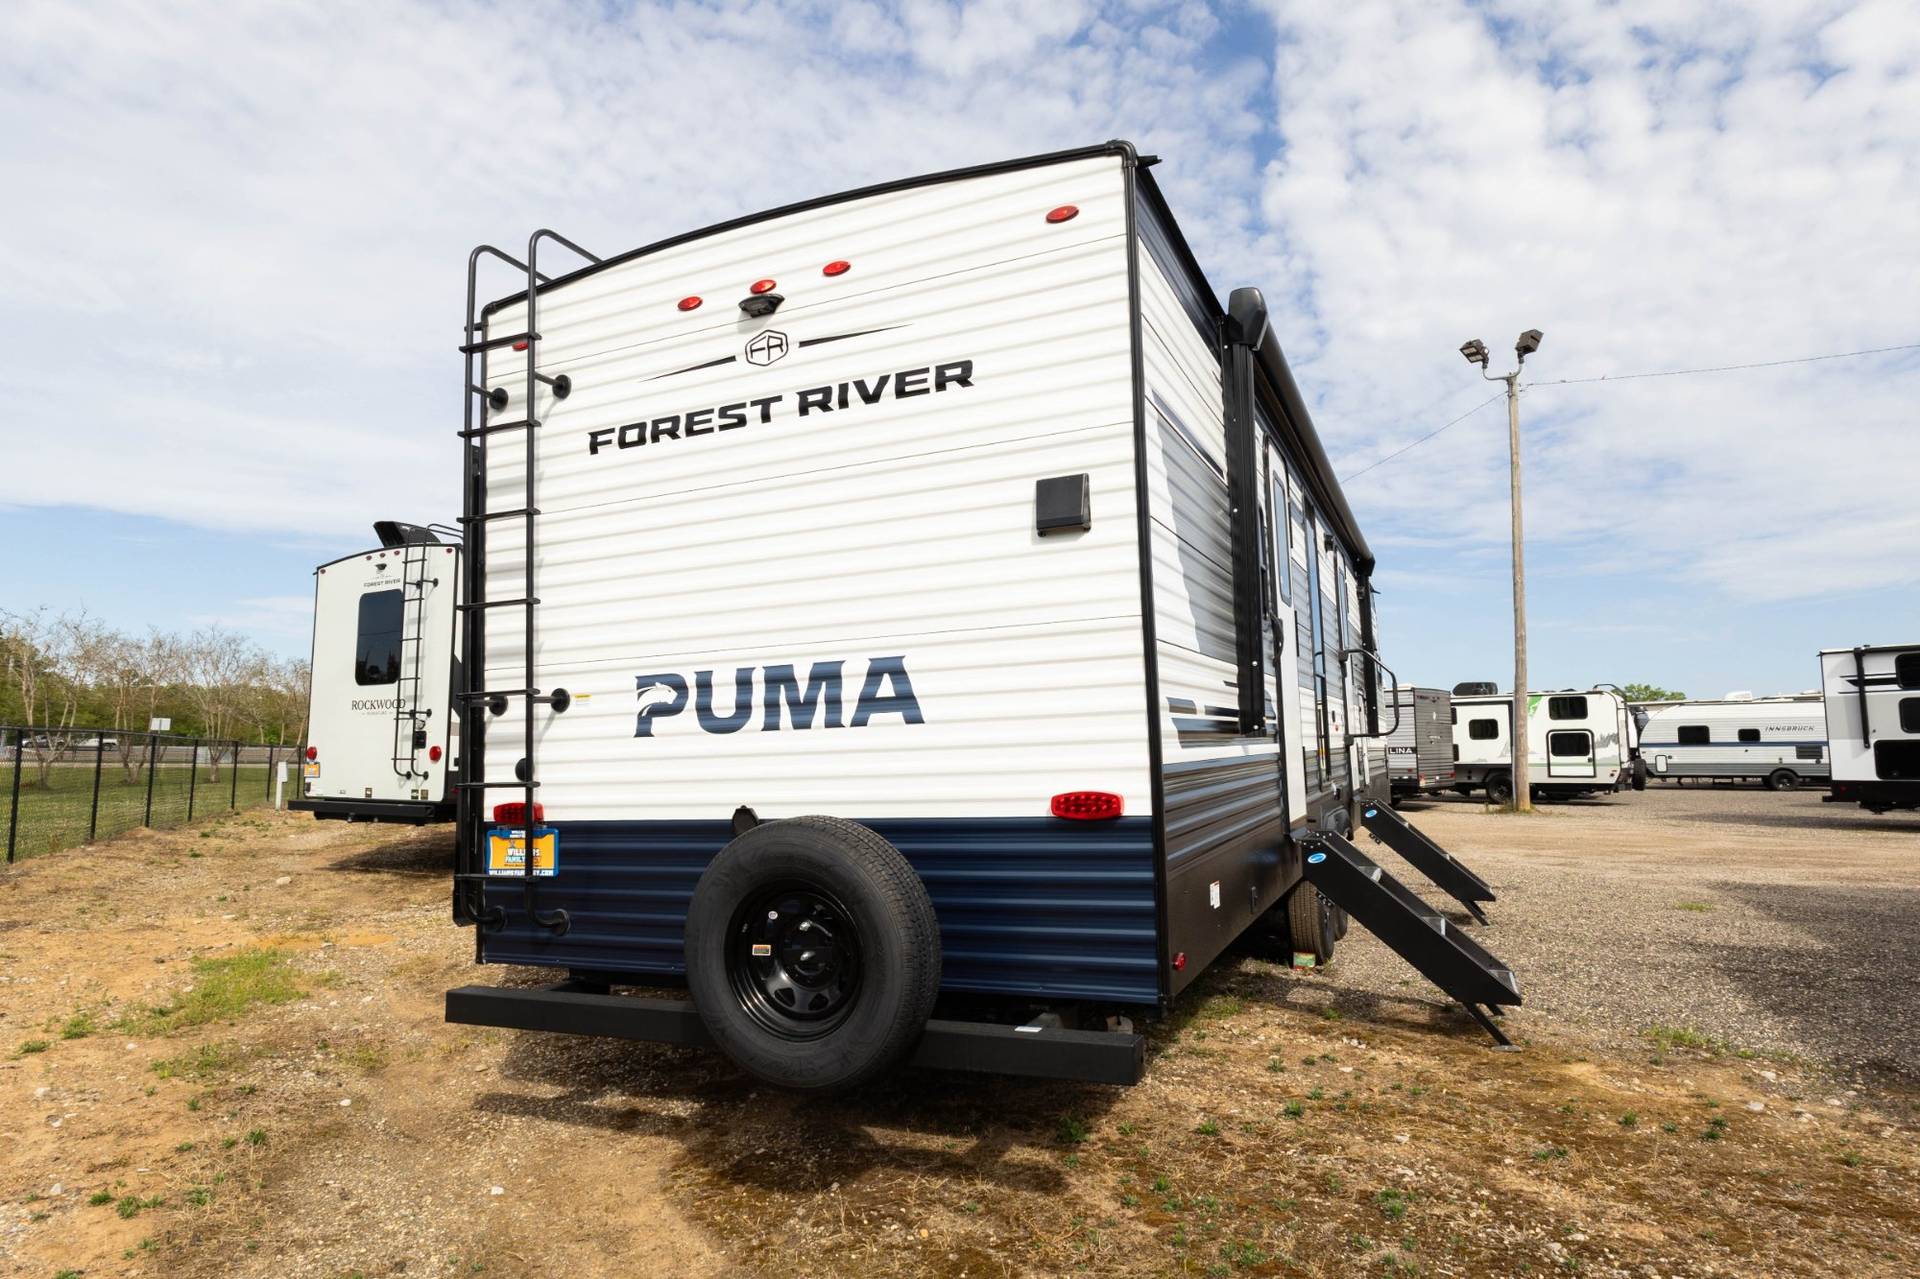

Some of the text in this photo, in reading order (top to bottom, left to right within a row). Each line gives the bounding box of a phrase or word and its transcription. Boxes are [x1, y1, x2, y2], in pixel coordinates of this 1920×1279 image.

[587, 359, 976, 456] FOREST RIVER
[351, 698, 406, 711] ROCKWOOD
[633, 655, 926, 738] PUMA
